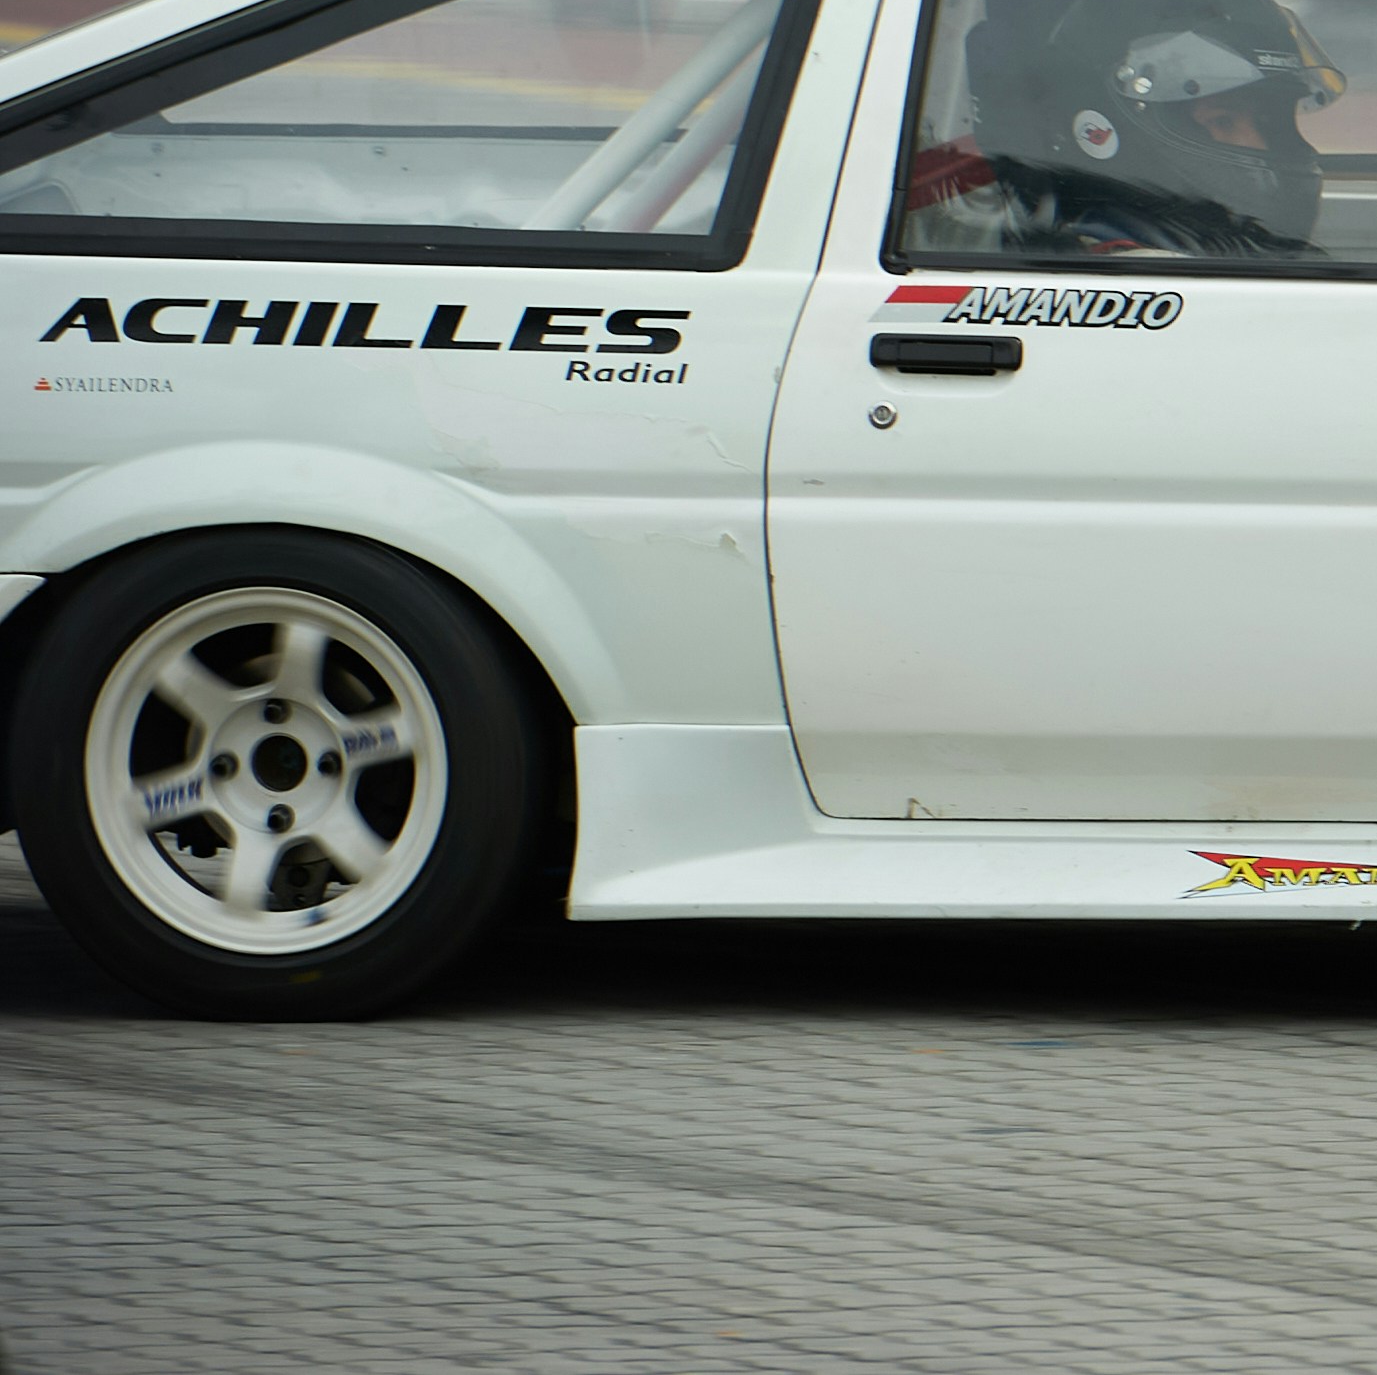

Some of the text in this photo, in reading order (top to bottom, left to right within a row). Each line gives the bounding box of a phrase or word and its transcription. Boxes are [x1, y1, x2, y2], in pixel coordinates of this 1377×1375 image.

[945, 286, 1183, 330] AMANDIO
[38, 297, 691, 356] ACHILLES
[54, 376, 174, 393] SYAILENDRA
[563, 361, 689, 386] Radial
